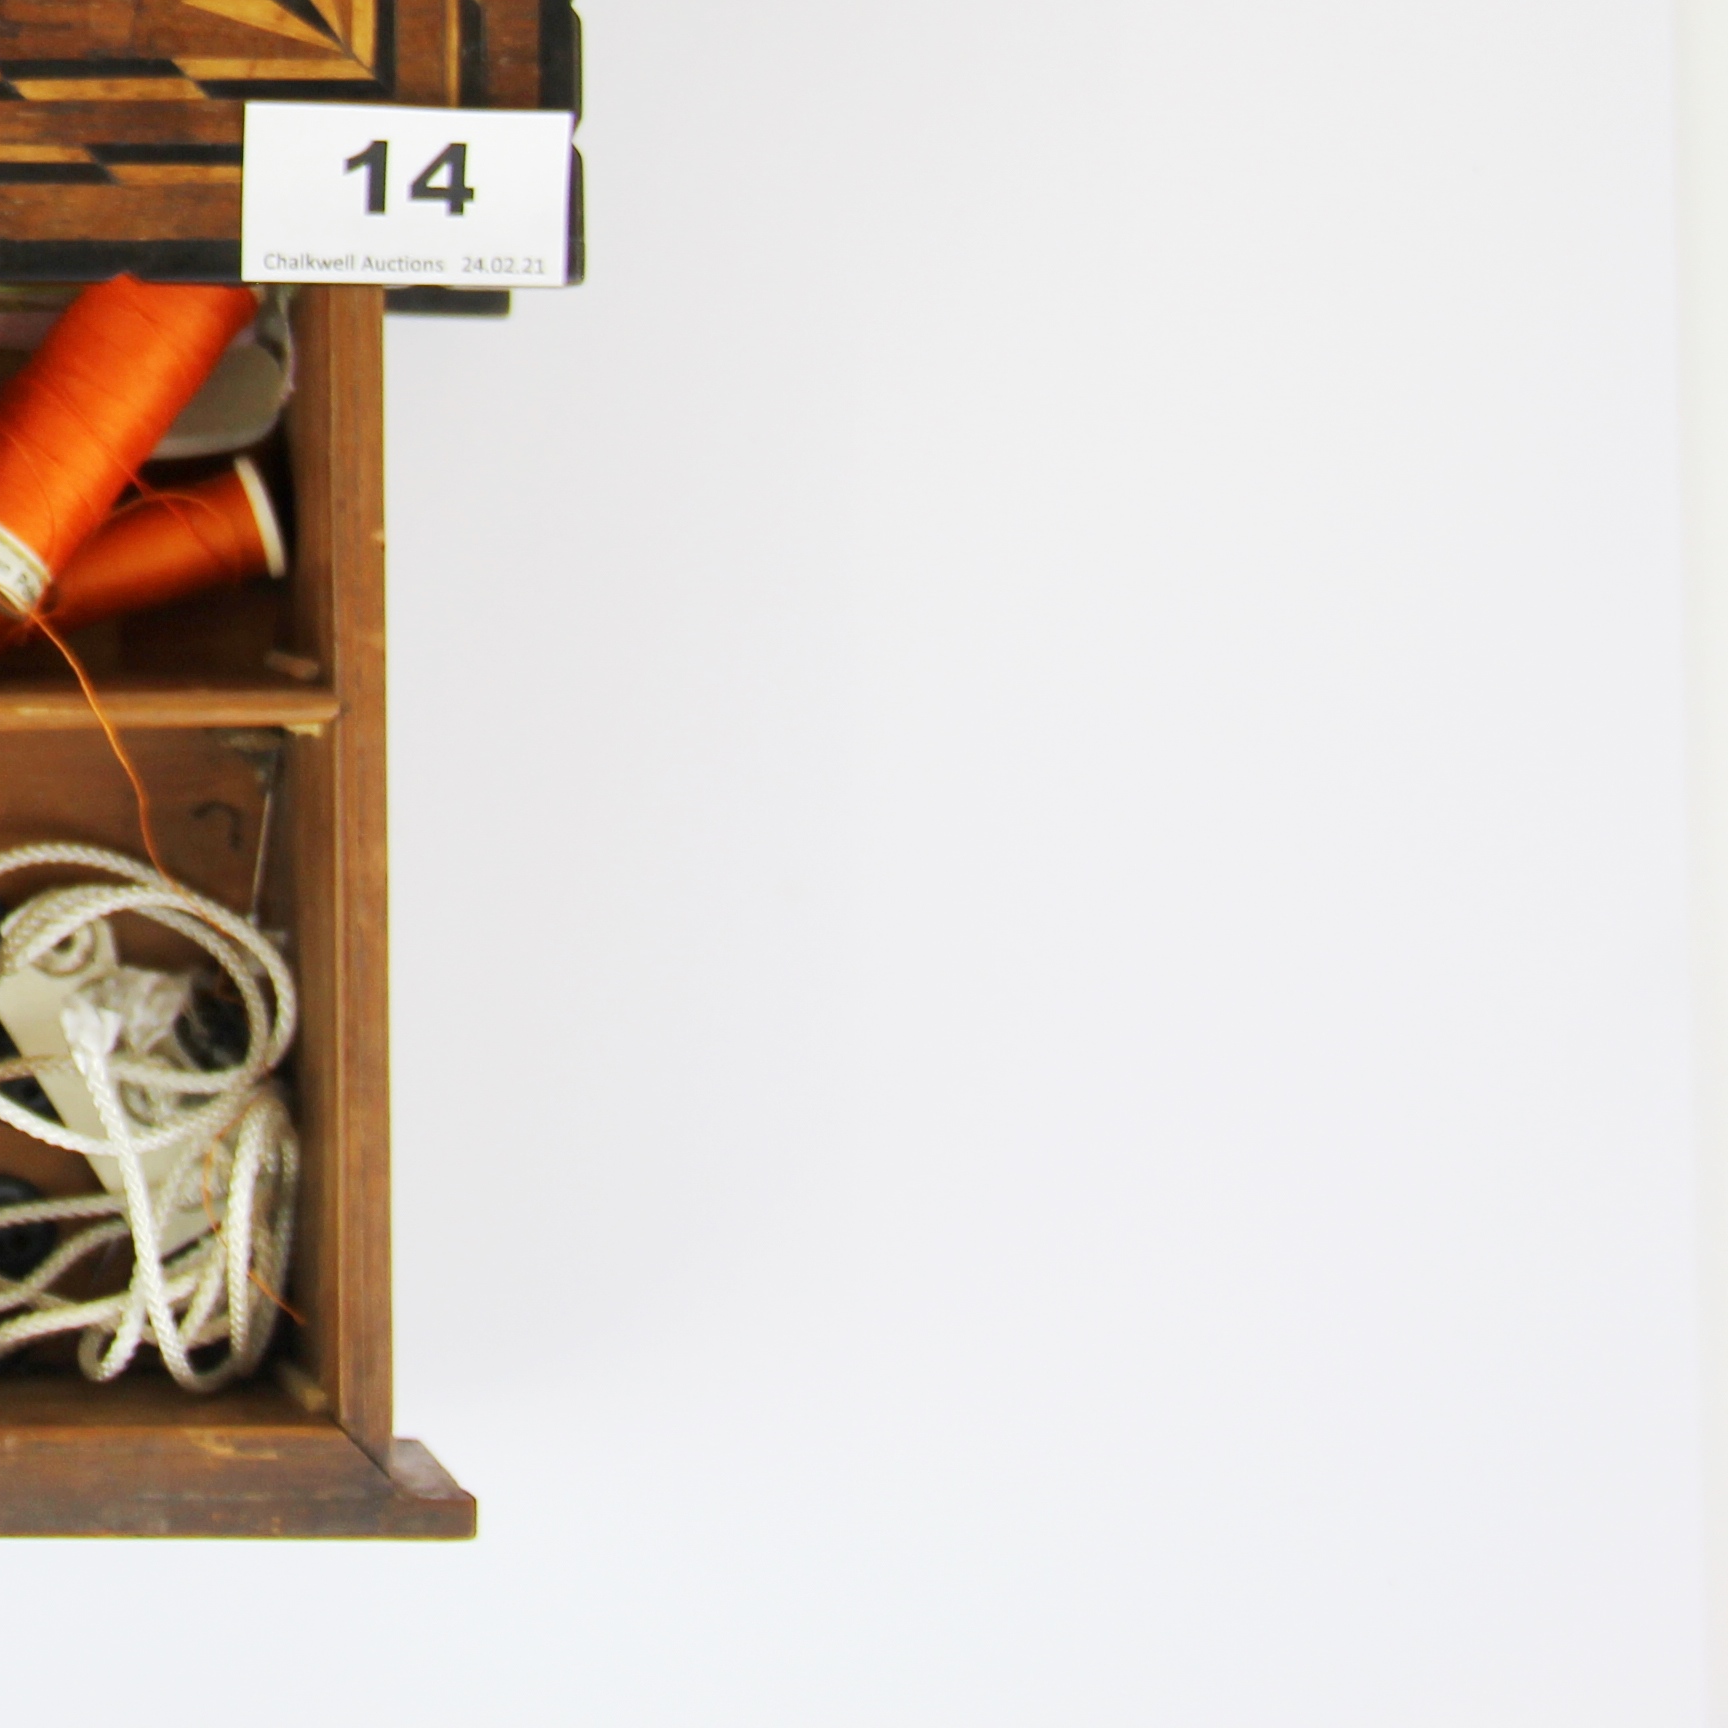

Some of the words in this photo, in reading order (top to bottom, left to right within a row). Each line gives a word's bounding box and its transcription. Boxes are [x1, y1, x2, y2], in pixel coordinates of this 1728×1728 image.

[343, 138, 476, 217] 14
[263, 252, 355, 272] Chalkwell
[362, 255, 444, 273] Auctions
[461, 256, 545, 275] 24.02.21
